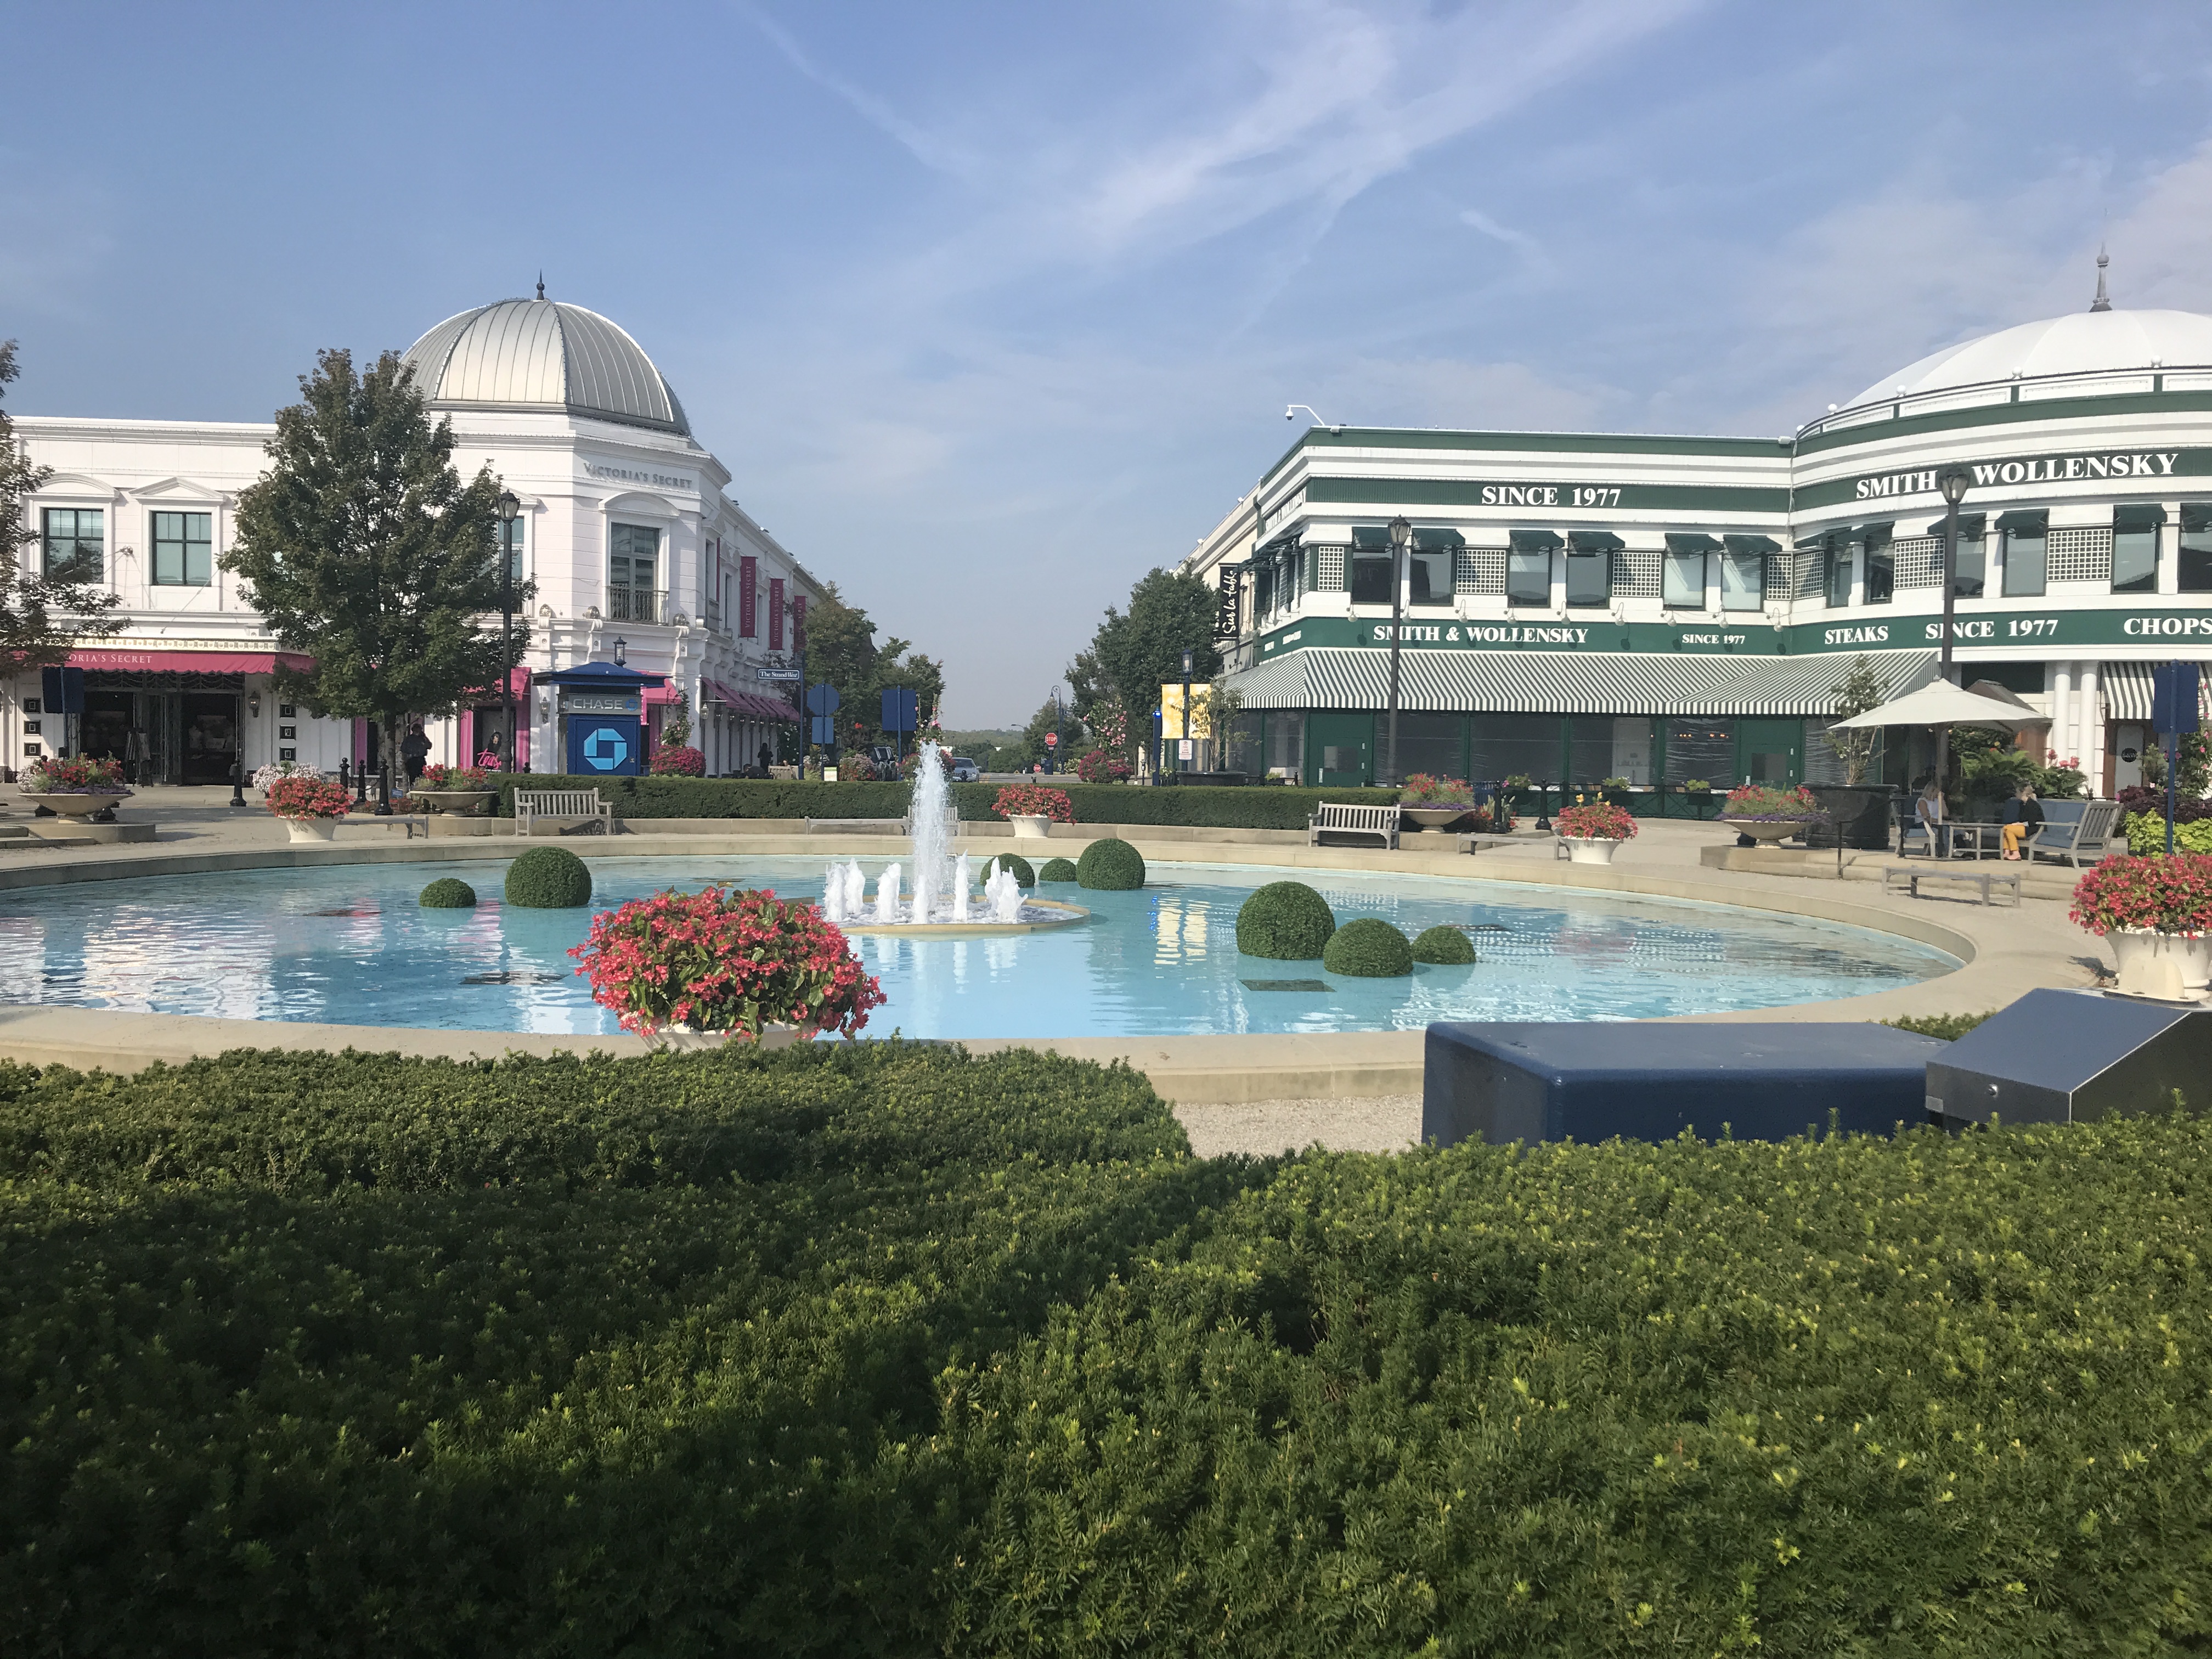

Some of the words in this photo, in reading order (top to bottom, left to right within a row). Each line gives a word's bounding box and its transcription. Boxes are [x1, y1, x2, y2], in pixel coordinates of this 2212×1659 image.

[584, 462, 648, 482] VICTORIA'S
[652, 474, 692, 488] SECRET
[1857, 470, 1938, 499] SMITH
[1971, 454, 2179, 485] WOLLENSKY
[1482, 486, 1558, 505] SINCE
[1572, 488, 1621, 506] 1977
[1223, 598, 1236, 610] la
[1222, 612, 1237, 634] Sur
[1925, 621, 1995, 639] SINCE
[2008, 619, 2058, 636] 1977
[2124, 618, 2212, 635] CHOPS
[1373, 625, 1440, 641] SMITH
[1446, 627, 1460, 641] &
[1465, 627, 1589, 643] WOLLENSKY
[1682, 634, 1719, 644] SINCE
[1723, 635, 1746, 644] 1977
[1825, 625, 1888, 644] STEAKS
[69, 654, 106, 662] ORIA'S
[111, 654, 152, 663] SECRET
[573, 698, 623, 710] CHASE
